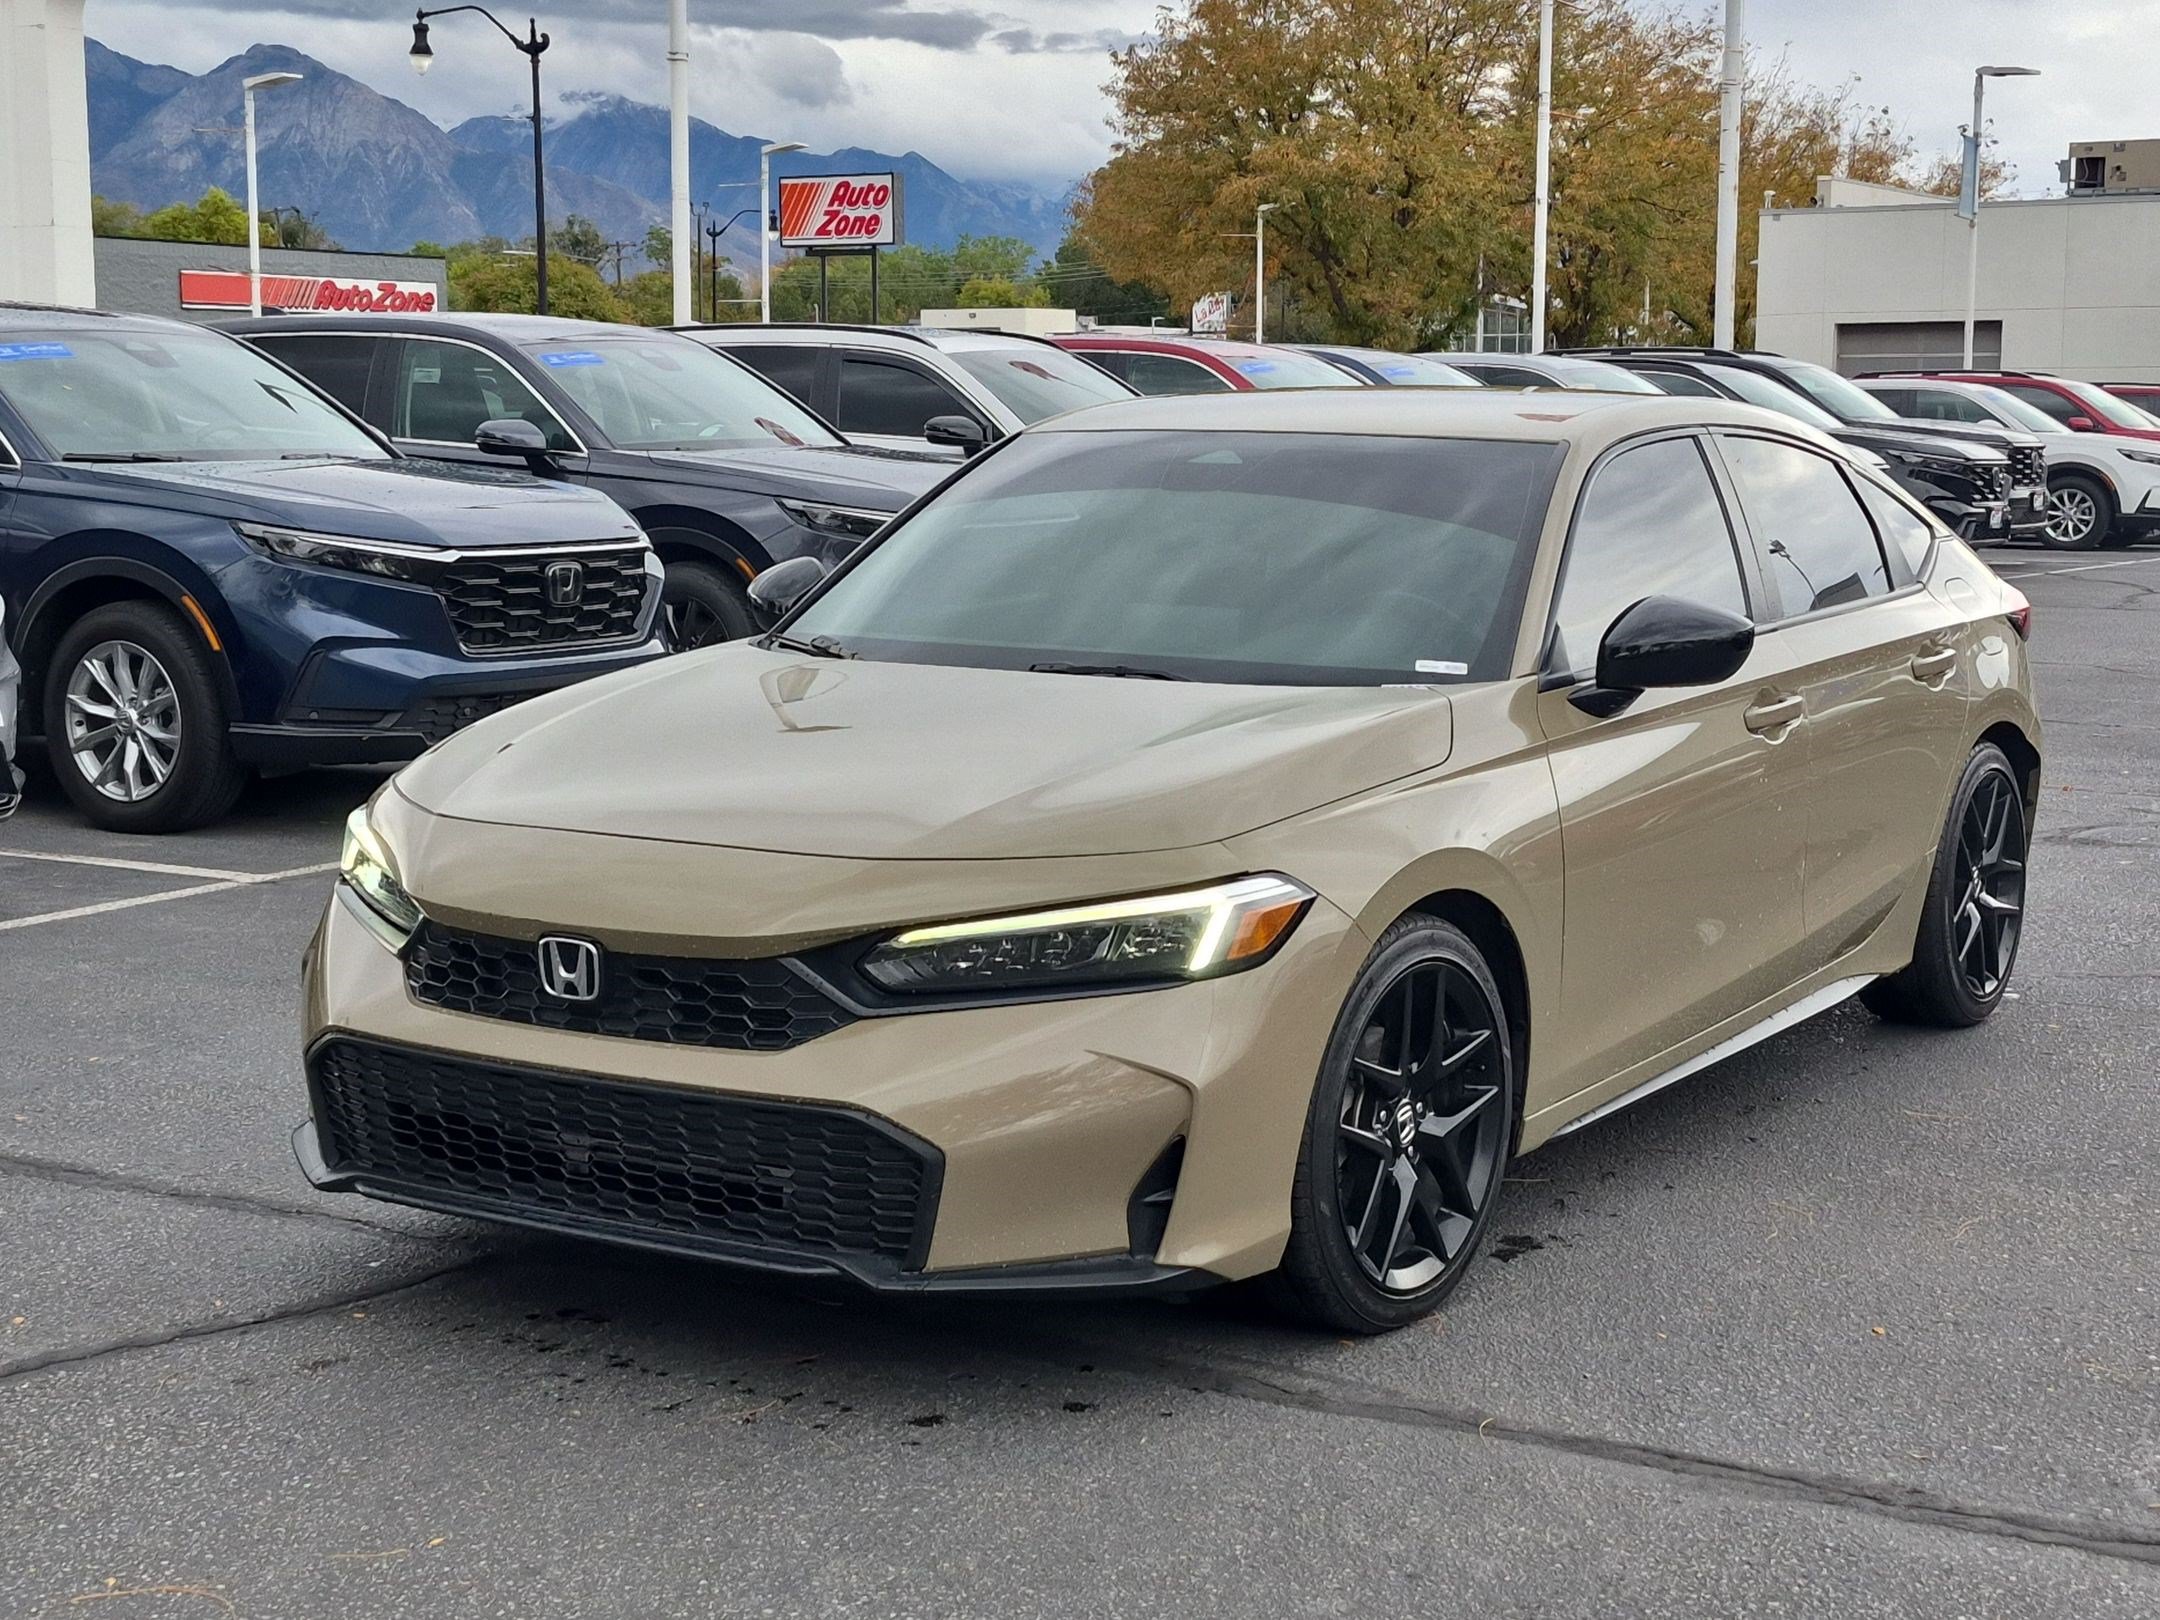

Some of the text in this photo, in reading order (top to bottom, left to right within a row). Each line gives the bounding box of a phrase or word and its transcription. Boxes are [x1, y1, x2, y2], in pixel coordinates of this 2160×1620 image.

[828, 181, 889, 207] Auto
[815, 209, 880, 237] Zone
[312, 280, 434, 312] AutoZone
